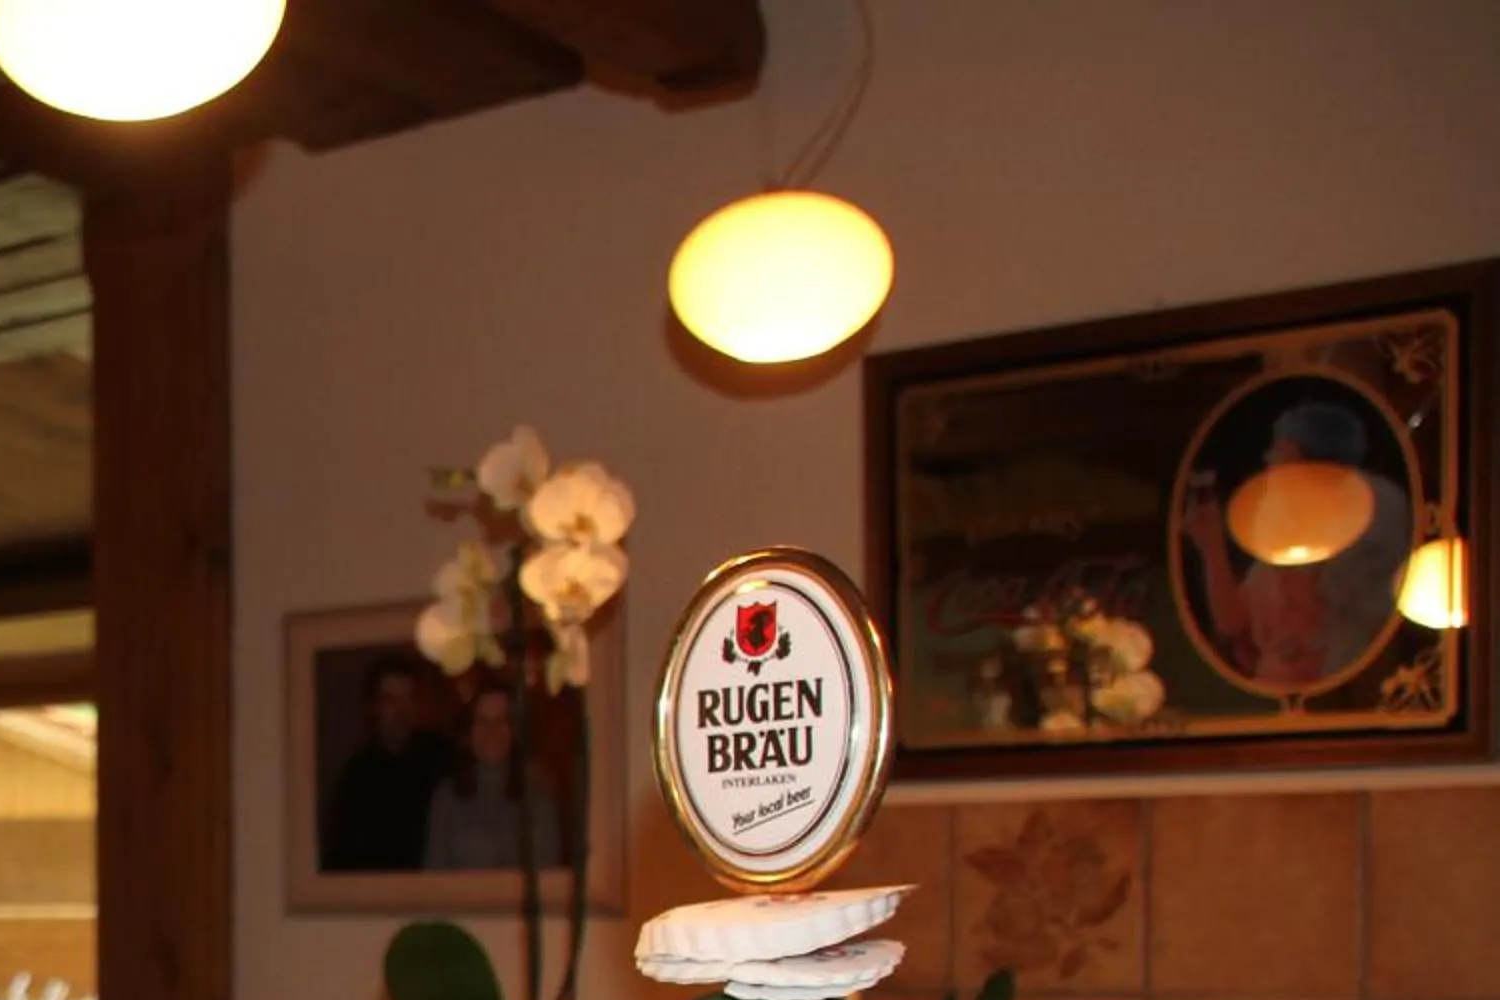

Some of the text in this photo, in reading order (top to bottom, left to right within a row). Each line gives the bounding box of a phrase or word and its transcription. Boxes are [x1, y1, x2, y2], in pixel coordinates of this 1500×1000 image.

[697, 677, 823, 728] RUGEN
[707, 725, 813, 773] BRÄU
[721, 774, 797, 789] INTERLAKEN
[732, 786, 812, 829] Your local beer
